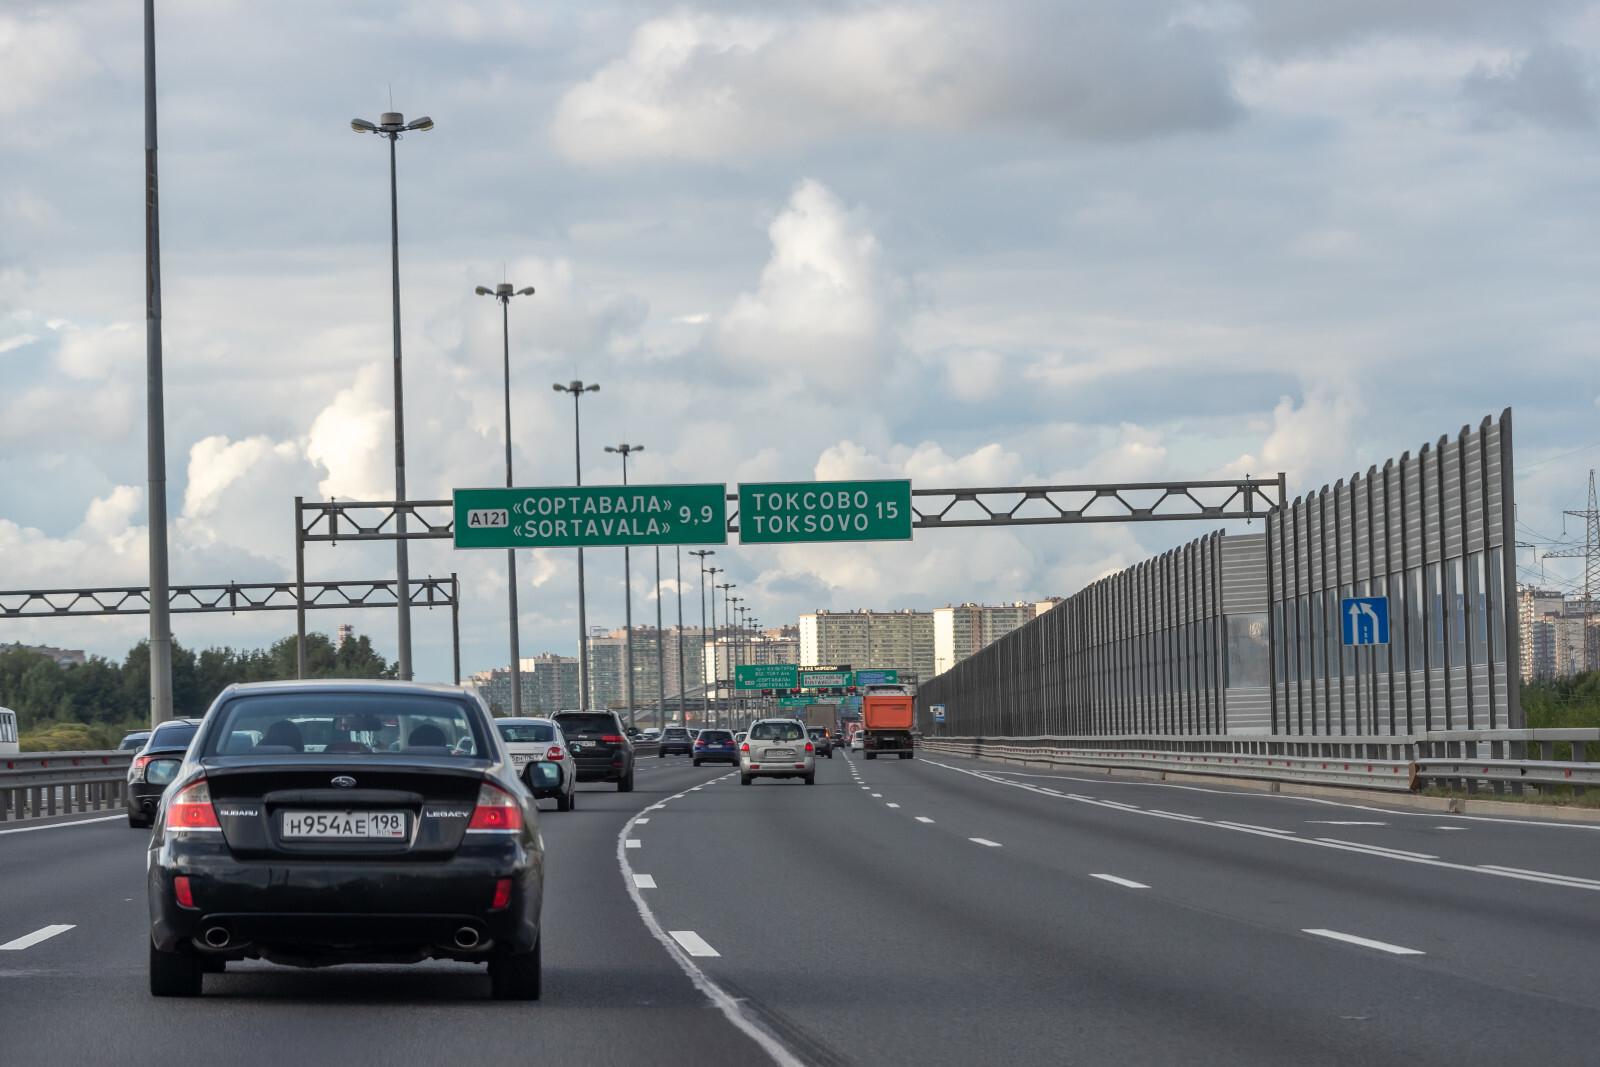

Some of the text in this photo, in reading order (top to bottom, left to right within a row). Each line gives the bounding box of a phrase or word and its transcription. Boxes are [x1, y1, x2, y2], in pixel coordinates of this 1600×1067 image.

[513, 495, 672, 515] «СОРТАВАЛА»
[752, 491, 868, 511] ТОКСОВО
[875, 501, 898, 519] 15
[679, 505, 713, 525] 9,9
[753, 513, 868, 533] TOKSOVO
[513, 518, 671, 538] «SORTAVALA»
[220, 809, 258, 817] SUBARU
[371, 815, 399, 829] 198
